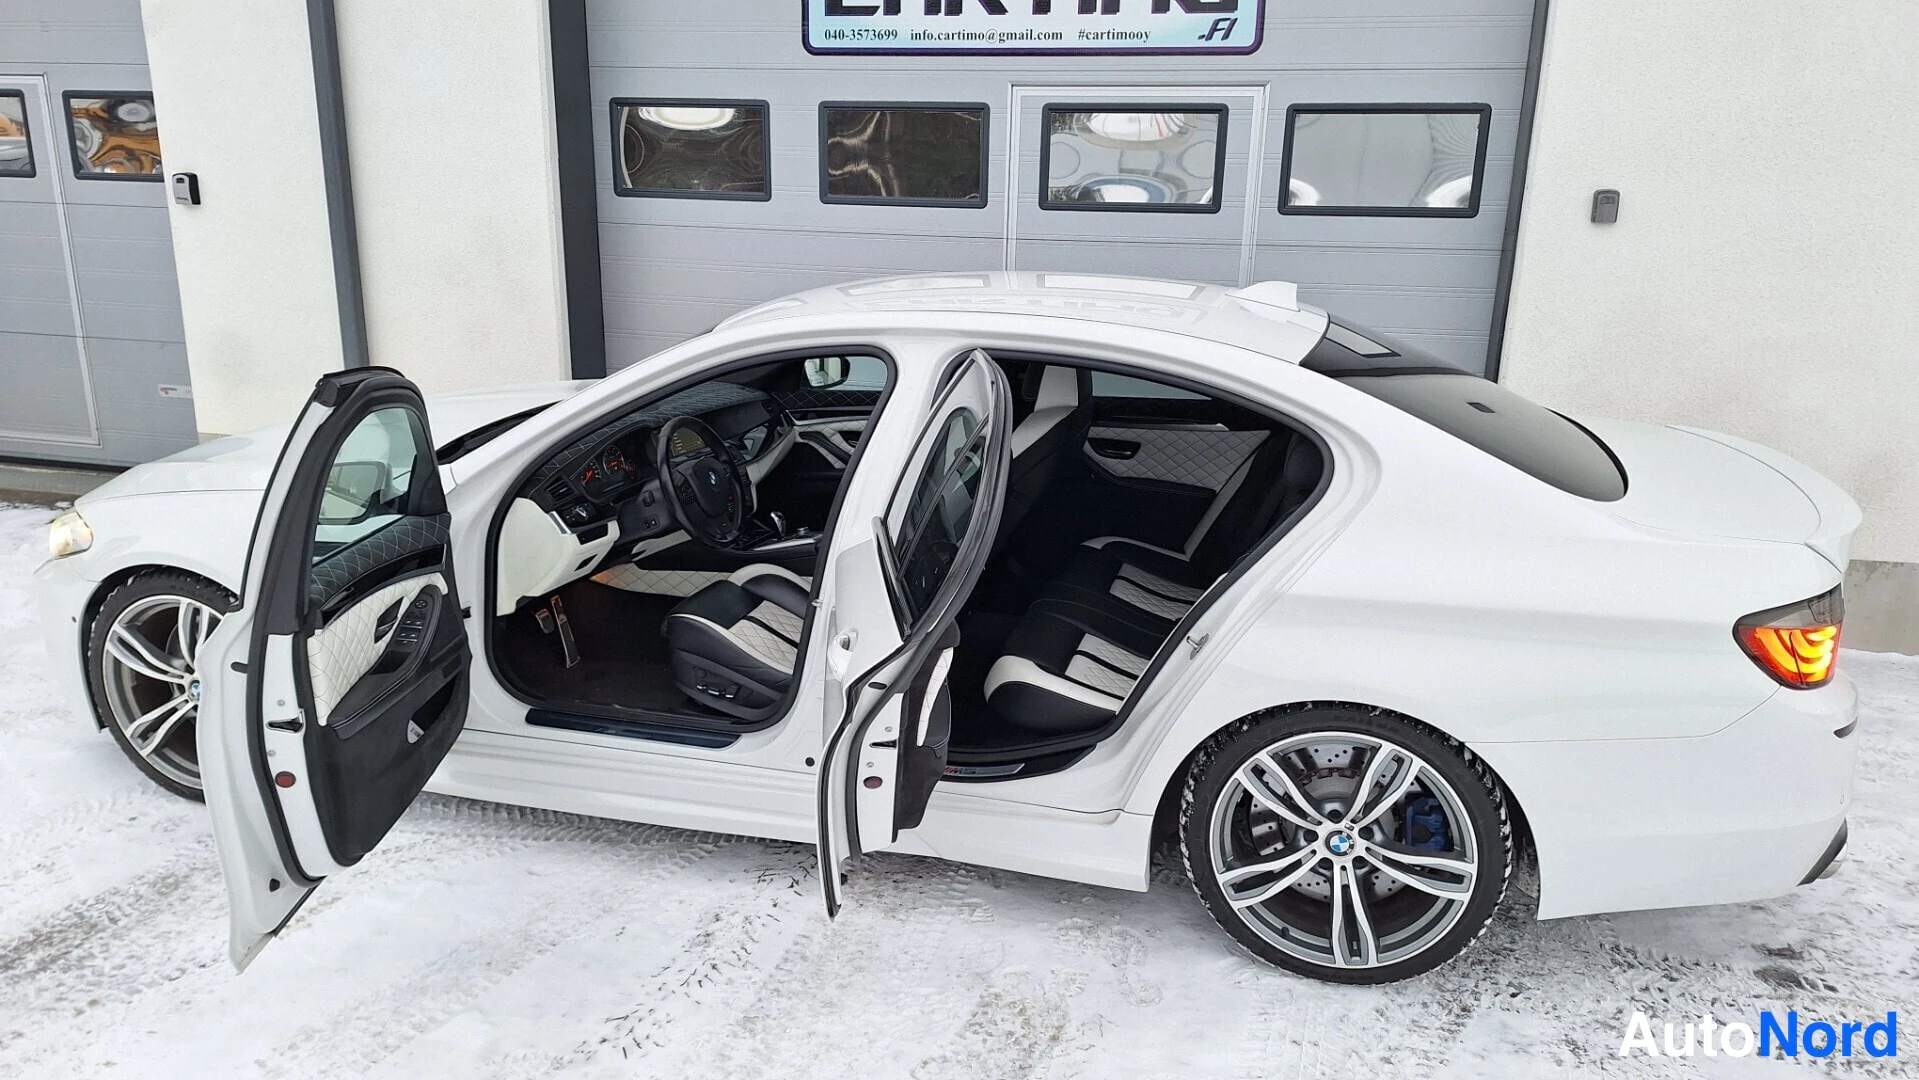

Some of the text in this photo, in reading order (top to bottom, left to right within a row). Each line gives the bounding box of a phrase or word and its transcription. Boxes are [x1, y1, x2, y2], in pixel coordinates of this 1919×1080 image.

[824, 28, 1151, 43] 040-3573699 info.cartimo@gmail.com #cartimooy
